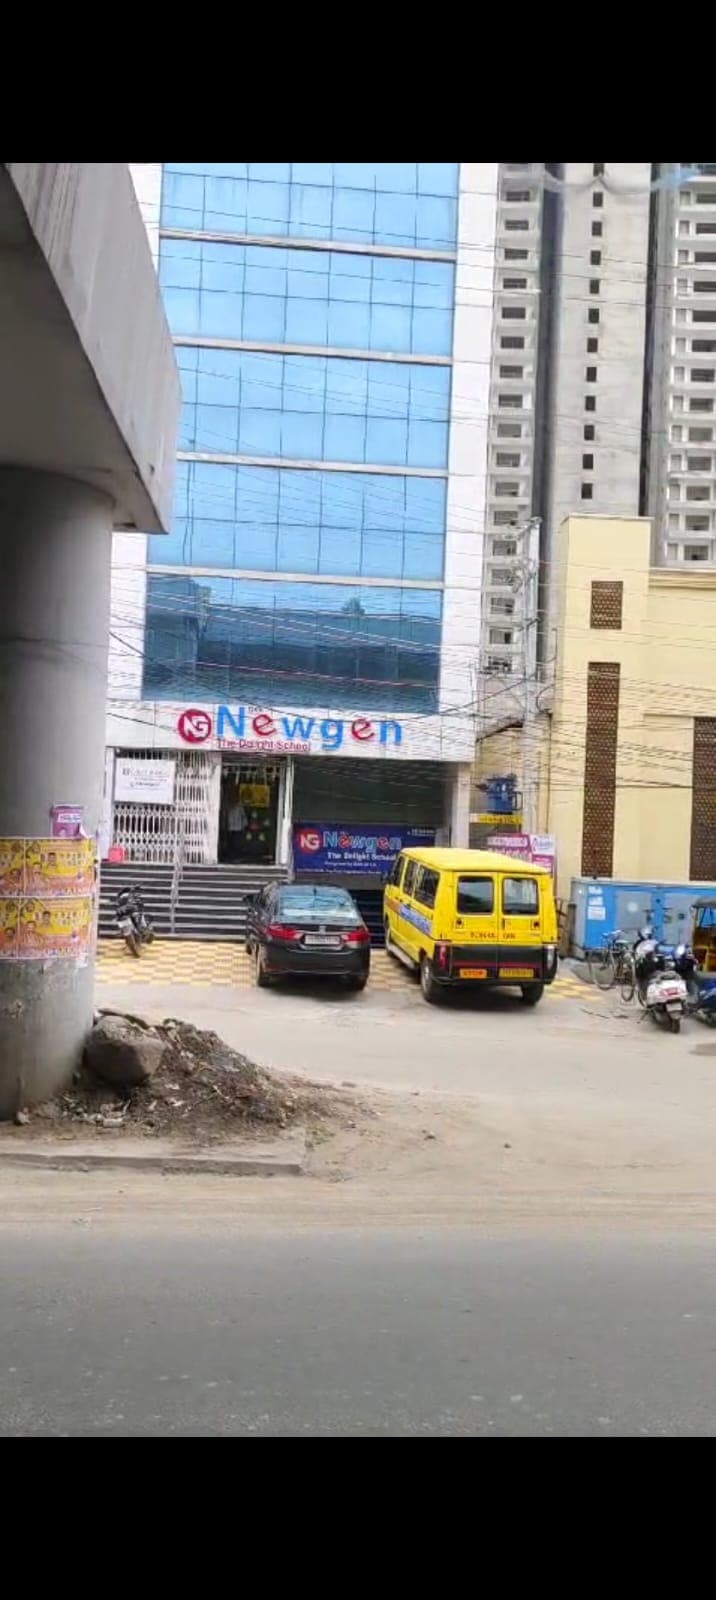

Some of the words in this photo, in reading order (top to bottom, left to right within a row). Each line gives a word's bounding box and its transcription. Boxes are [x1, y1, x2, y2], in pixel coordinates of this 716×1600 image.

[217, 706, 403, 750] Newgen
[278, 740, 312, 751] School
[322, 831, 402, 853] Newgen
[328, 851, 342, 860] The
